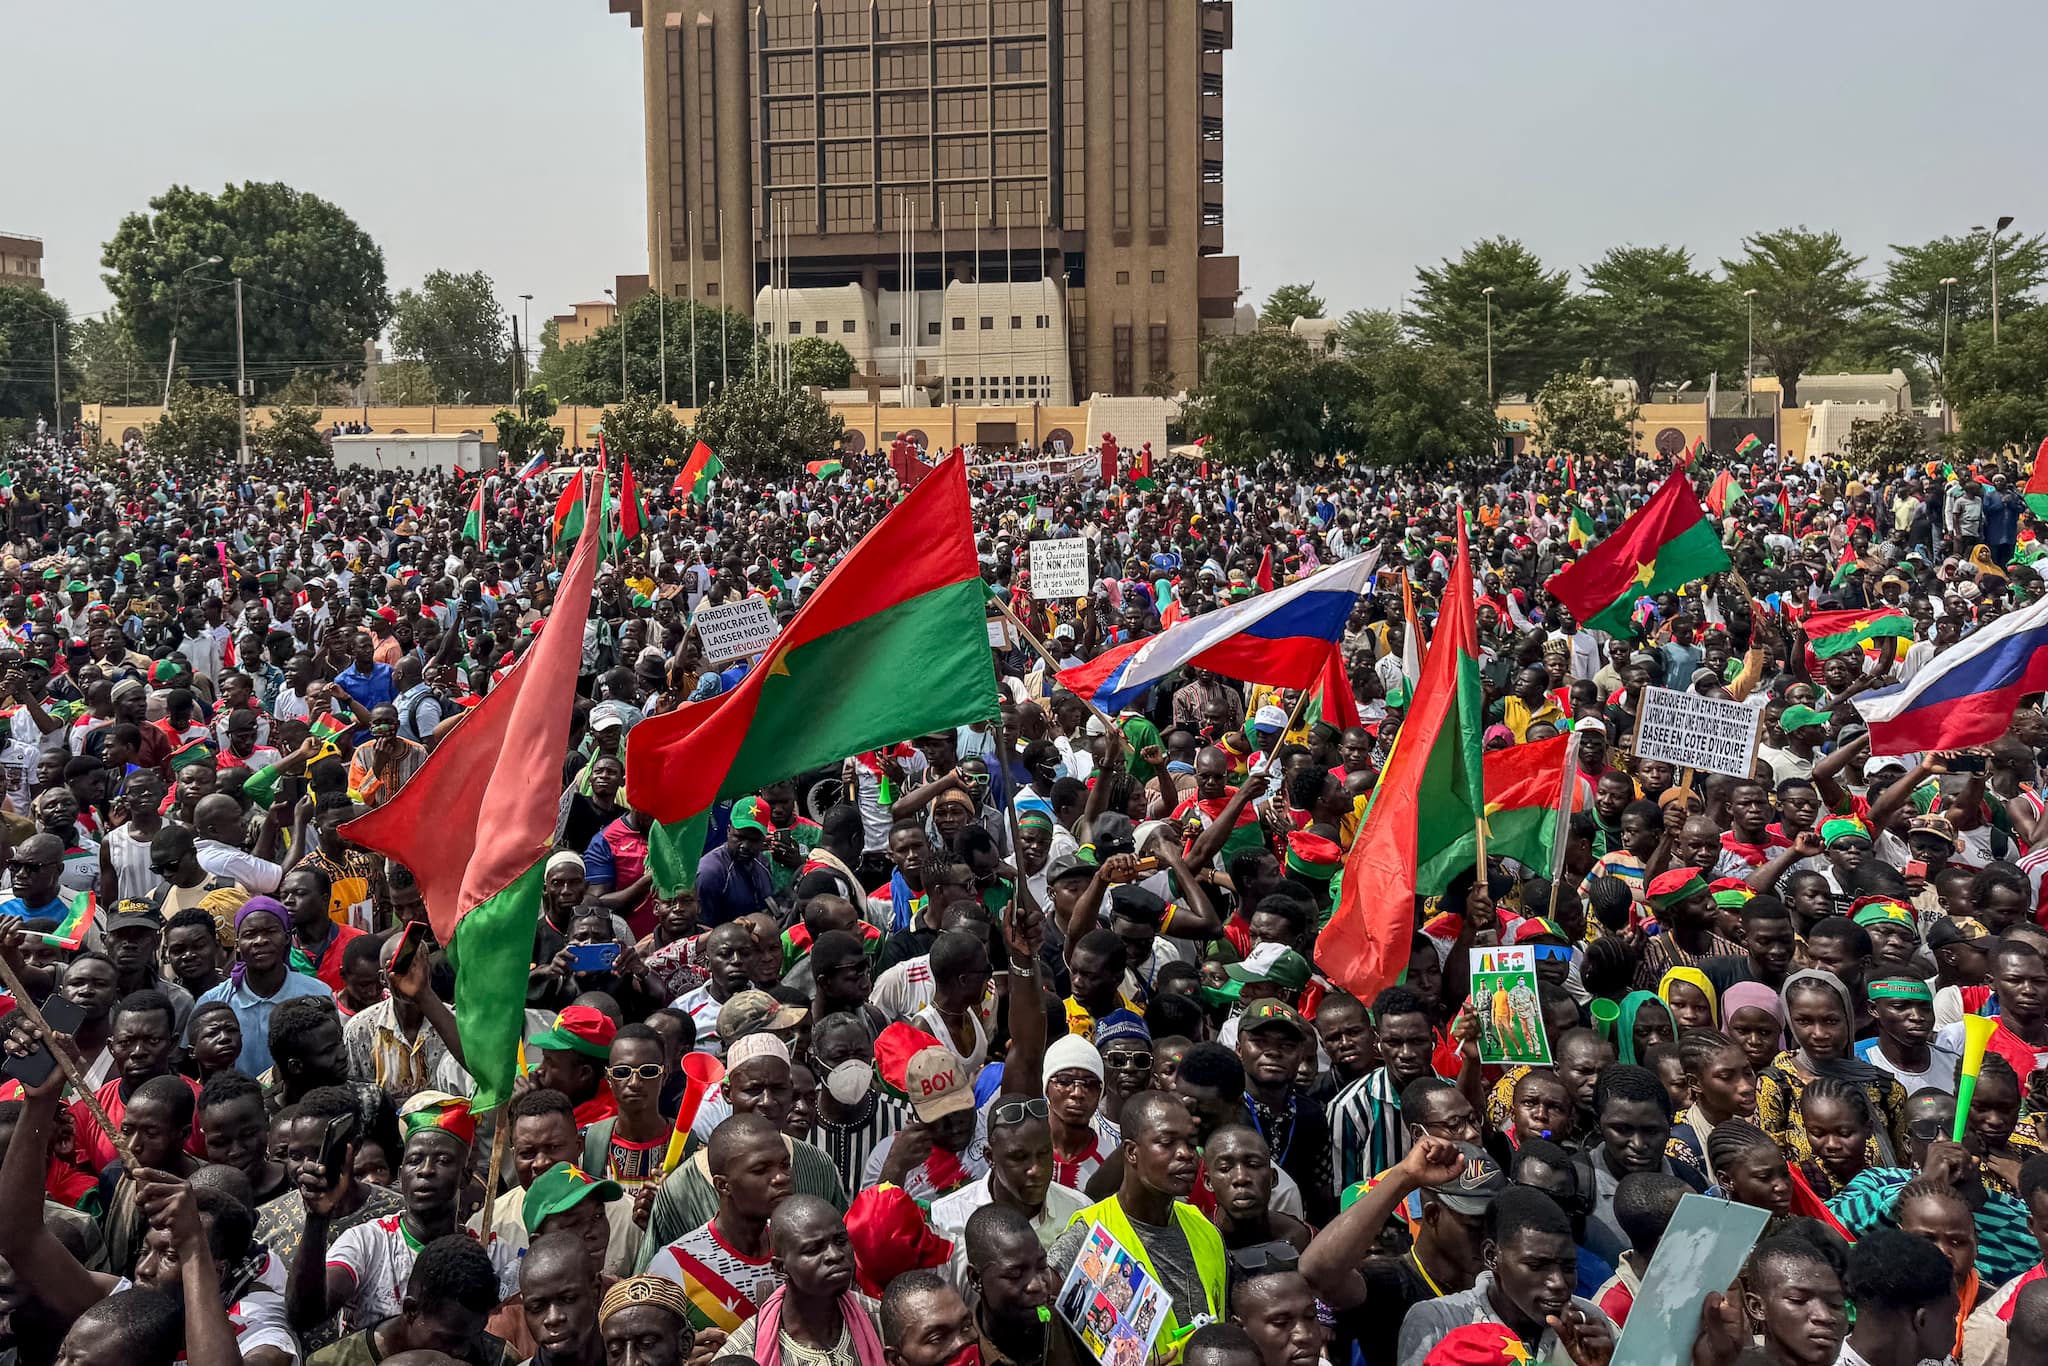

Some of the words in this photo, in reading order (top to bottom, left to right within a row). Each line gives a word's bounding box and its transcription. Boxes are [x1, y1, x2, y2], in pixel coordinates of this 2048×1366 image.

[1046, 559, 1062, 570] NON
[1070, 558, 1085, 569] NON
[1033, 580, 1042, 589] et
[1051, 580, 1063, 588] ses
[1048, 588, 1075, 596] locaux
[697, 607, 734, 623] GARDER
[733, 600, 764, 615] VOTRE
[700, 614, 758, 636] DÉMOCRATIE
[757, 612, 769, 623] ET
[707, 630, 744, 647] LAISSER
[744, 624, 771, 637] NOUS
[708, 646, 734, 660] NOTRE
[1680, 695, 1692, 711] EST
[1691, 697, 1700, 713] UN
[1700, 699, 1719, 717] ETATS
[1719, 702, 1753, 723] TERRORISTE
[1642, 724, 1670, 744] BASEE
[1670, 730, 1683, 746] EN
[1684, 732, 1707, 751] COTE
[1708, 737, 1746, 759] D'IVOIRE
[1640, 741, 1652, 757] EST
[1652, 743, 1661, 758] UN
[1695, 751, 1713, 769] POUR
[1712, 753, 1744, 775] L'AFRIQUE
[1479, 951, 1526, 972] AES
[920, 1069, 954, 1097] BOY
